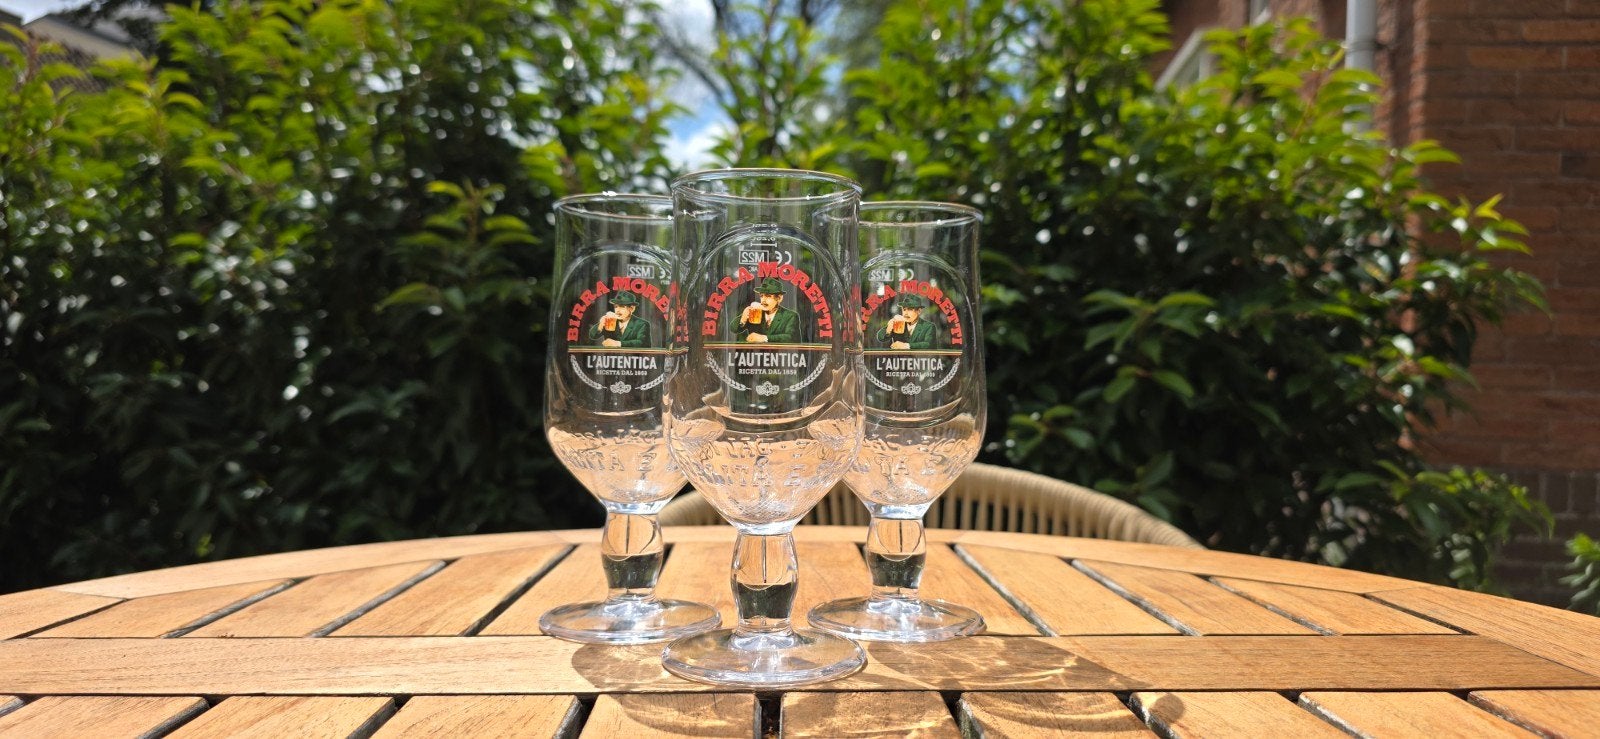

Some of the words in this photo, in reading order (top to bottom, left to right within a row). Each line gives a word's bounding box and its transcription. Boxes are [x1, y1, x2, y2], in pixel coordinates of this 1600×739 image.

[567, 280, 610, 342] BIRRA
[702, 266, 755, 336] BIRRA
[757, 261, 833, 338] MORETTI
[900, 280, 963, 345] MORETTI
